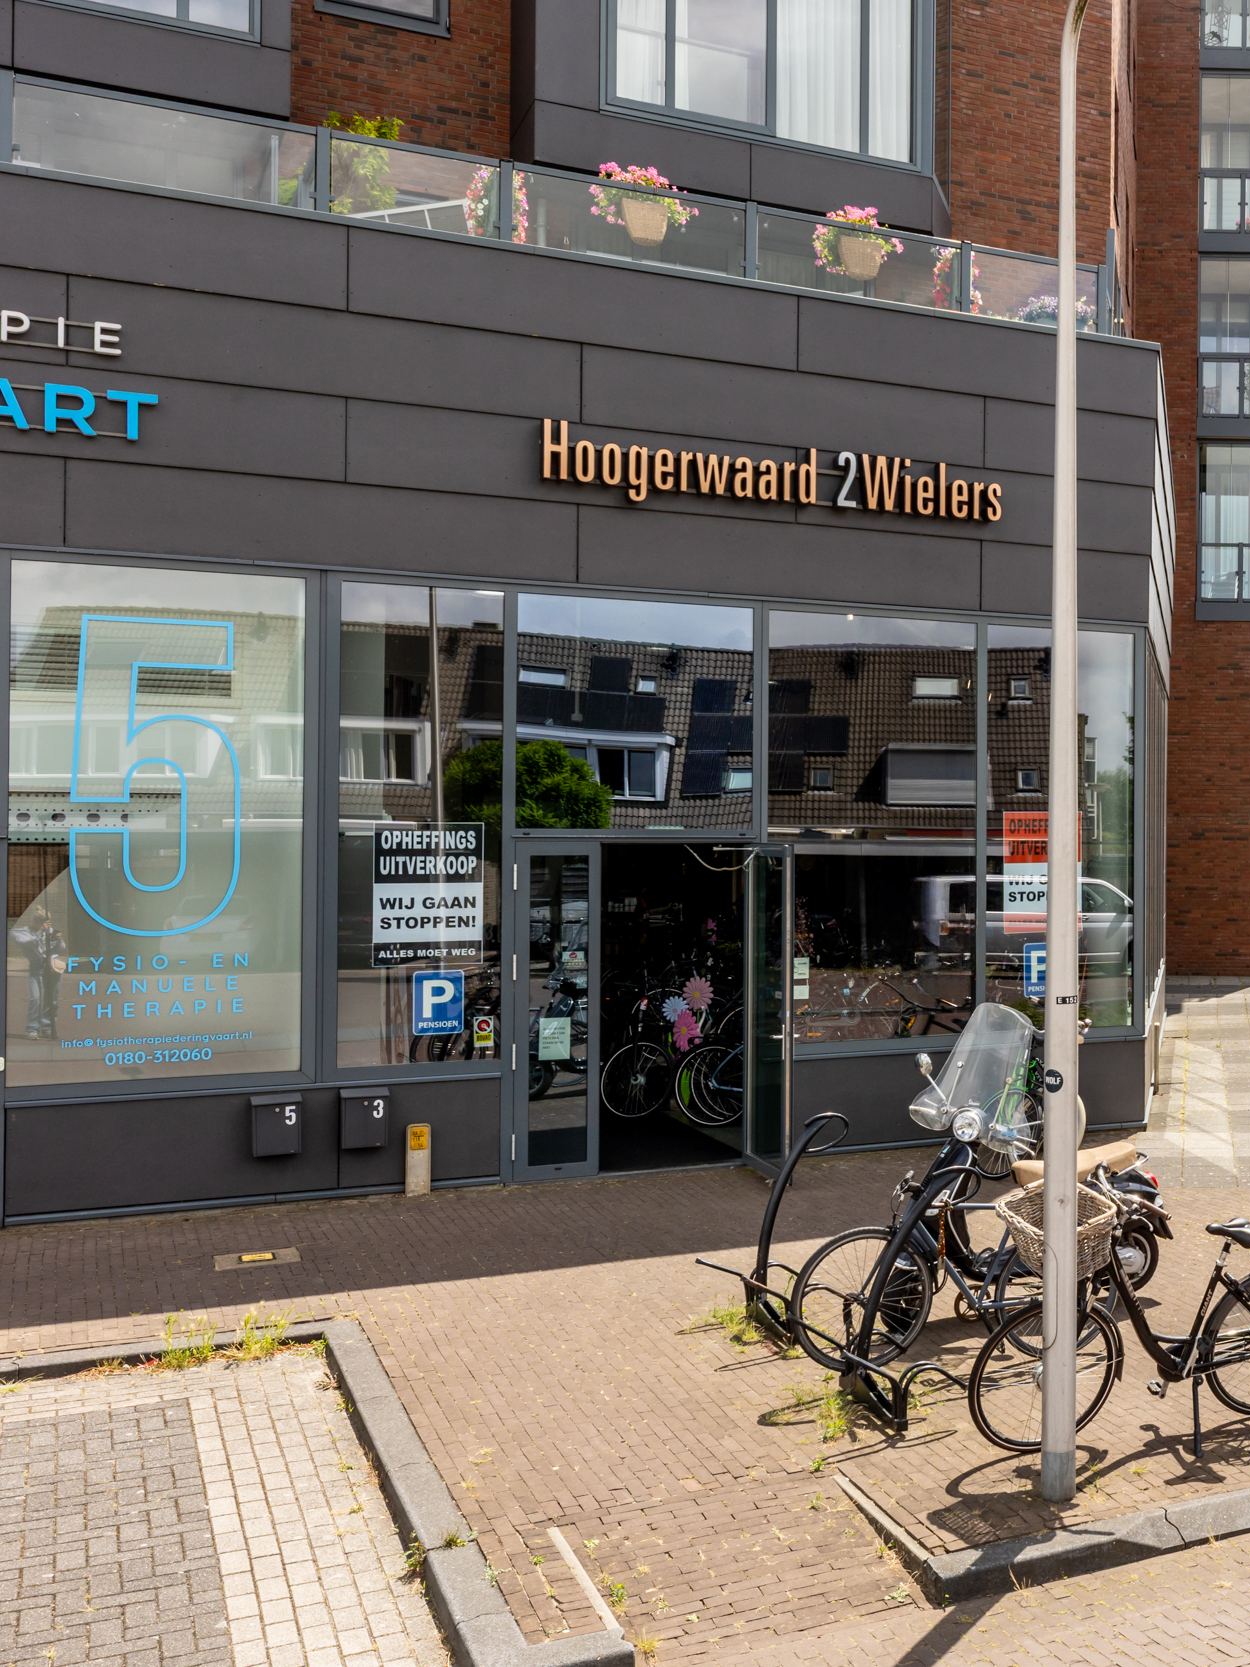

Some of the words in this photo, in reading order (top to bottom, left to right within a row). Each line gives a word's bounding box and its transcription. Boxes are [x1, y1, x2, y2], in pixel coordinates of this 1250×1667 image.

[0, 309, 123, 357] PIE
[541, 417, 818, 504] Hoogerwaard
[69, 613, 241, 937] 5
[380, 829, 477, 850] OPHEFFINGS
[379, 855, 477, 876] UITVERKOOP
[378, 896, 416, 911] WIJ
[421, 895, 477, 910] GAAN
[1008, 890, 1048, 903] STOP
[379, 915, 477, 930] STOPPEN!
[67, 954, 188, 973] FYSIO-
[212, 952, 249, 968] EN
[378, 949, 415, 959] ALLES
[417, 948, 449, 958] MOET
[451, 947, 477, 956] WEG
[78, 975, 239, 996] MANUELE
[71, 997, 244, 1020] THERAPIE
[422, 979, 455, 1019] P
[418, 1020, 459, 1029] PENSIOEN
[104, 1047, 213, 1066] 0180-312060
[284, 1105, 297, 1126] 5
[372, 1099, 384, 1119] 3
